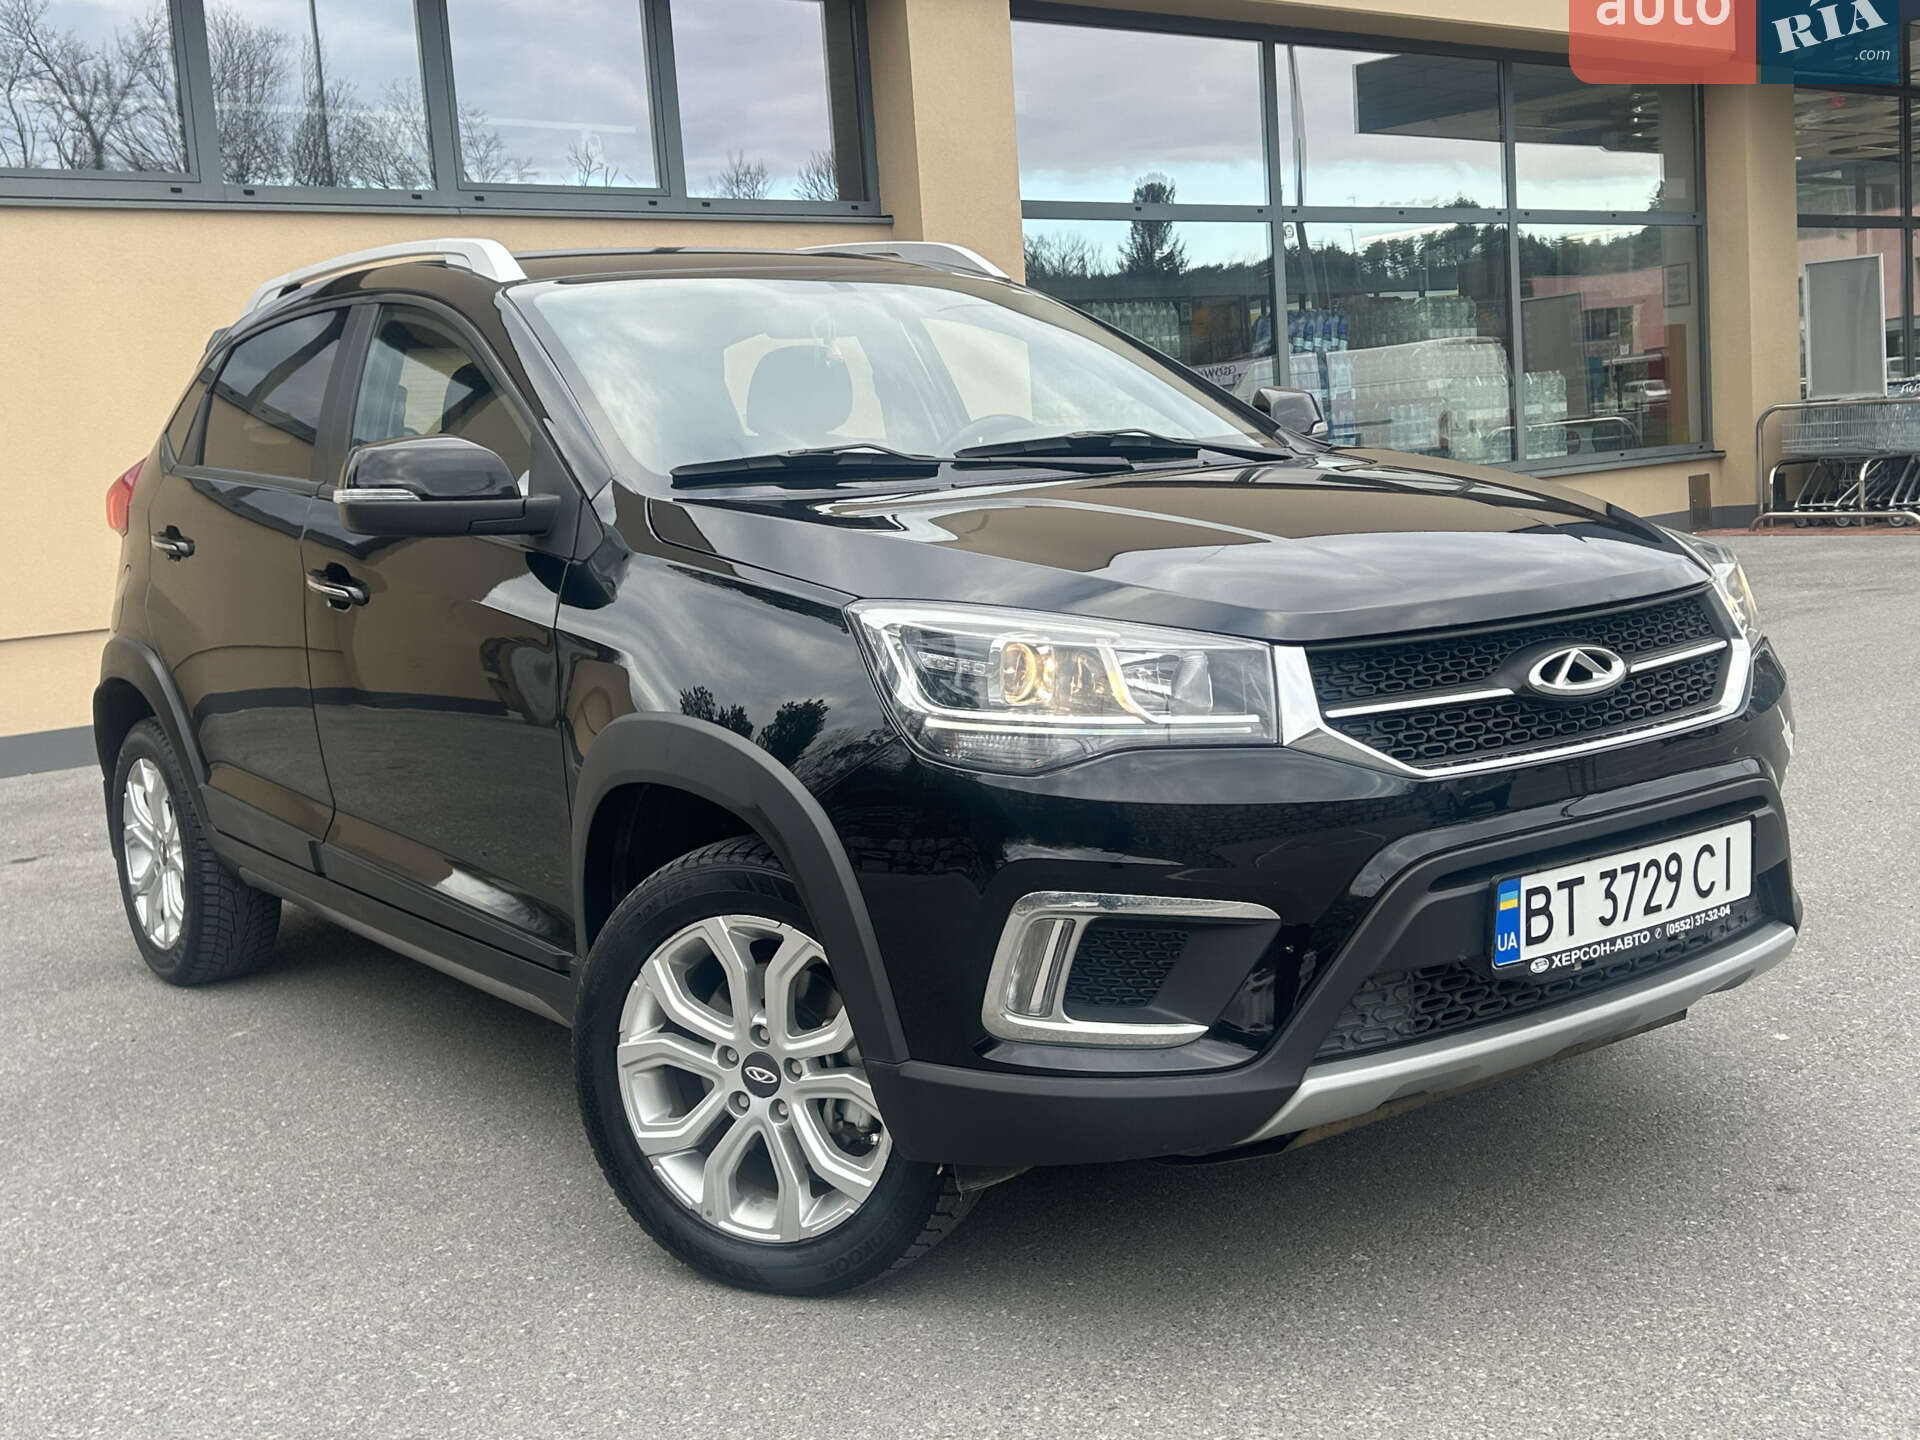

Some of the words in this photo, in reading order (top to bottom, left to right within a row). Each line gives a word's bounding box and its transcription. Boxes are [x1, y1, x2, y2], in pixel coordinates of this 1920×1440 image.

[1525, 876, 1585, 947] BT
[1598, 852, 1682, 927] 3729
[1693, 837, 1731, 899] CI
[1497, 931, 1518, 952] UA
[1551, 931, 1650, 969] ХЕРСОН-АВТО
[1666, 914, 1694, 937] (0552)
[1695, 904, 1731, 926] 37-32-04
